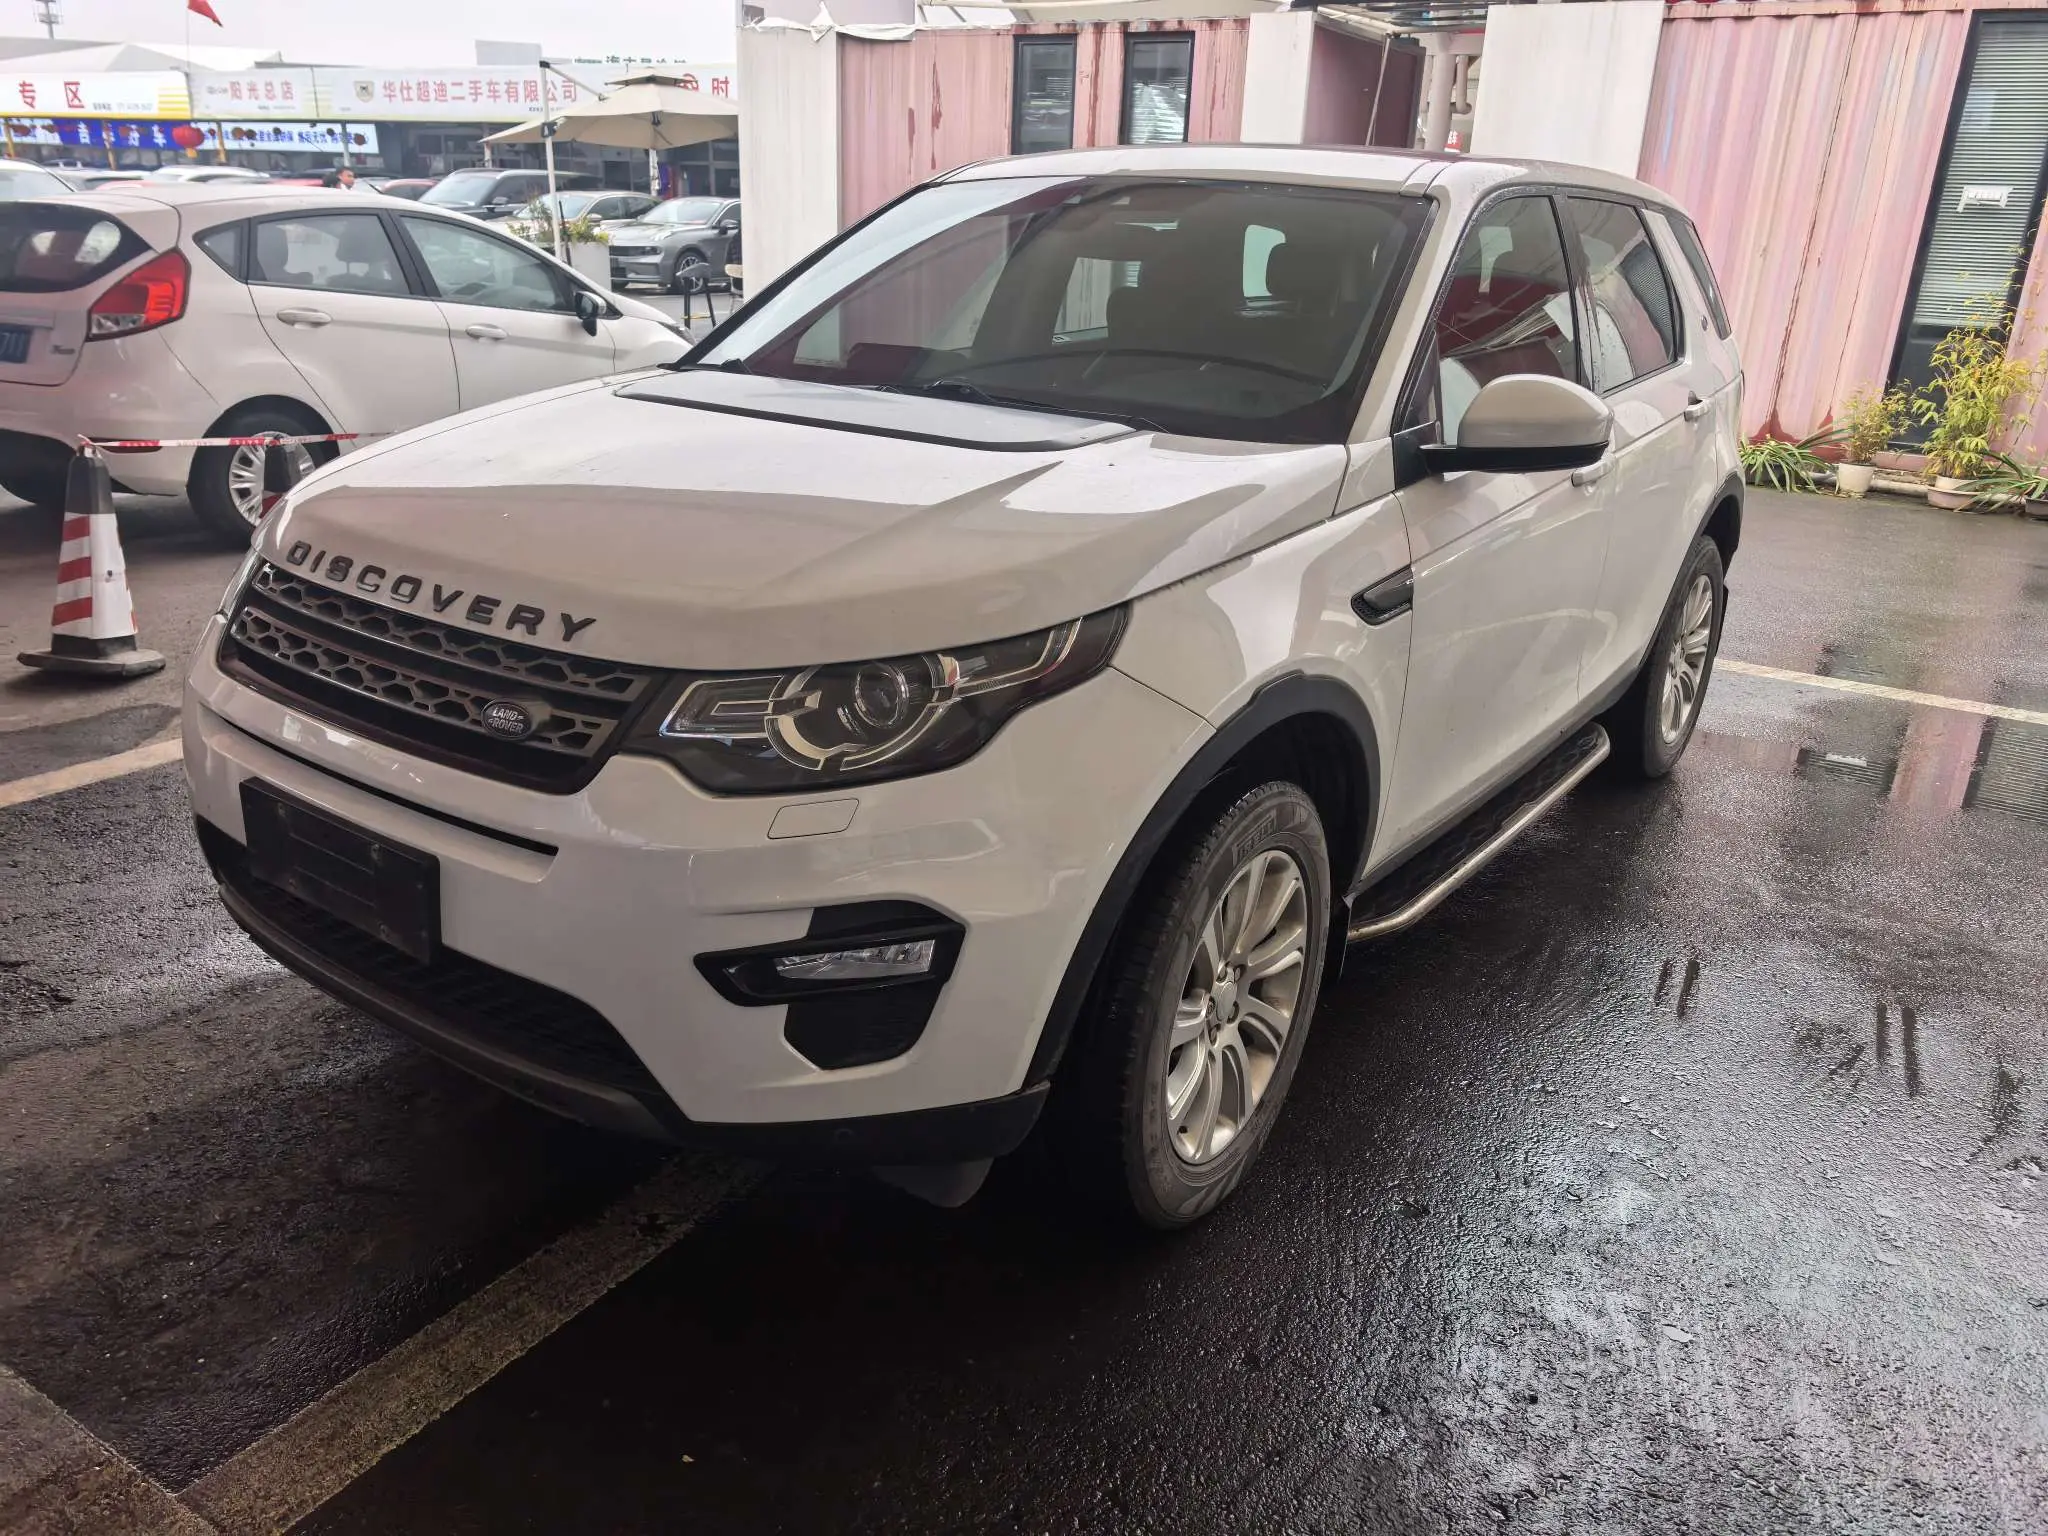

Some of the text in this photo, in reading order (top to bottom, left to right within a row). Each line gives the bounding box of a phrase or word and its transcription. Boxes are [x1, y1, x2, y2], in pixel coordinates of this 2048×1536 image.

[18, 80, 85, 109] 专区
[382, 79, 577, 104] 华仕超迪二手车有限公司
[286, 540, 597, 642] DISCOVERY
